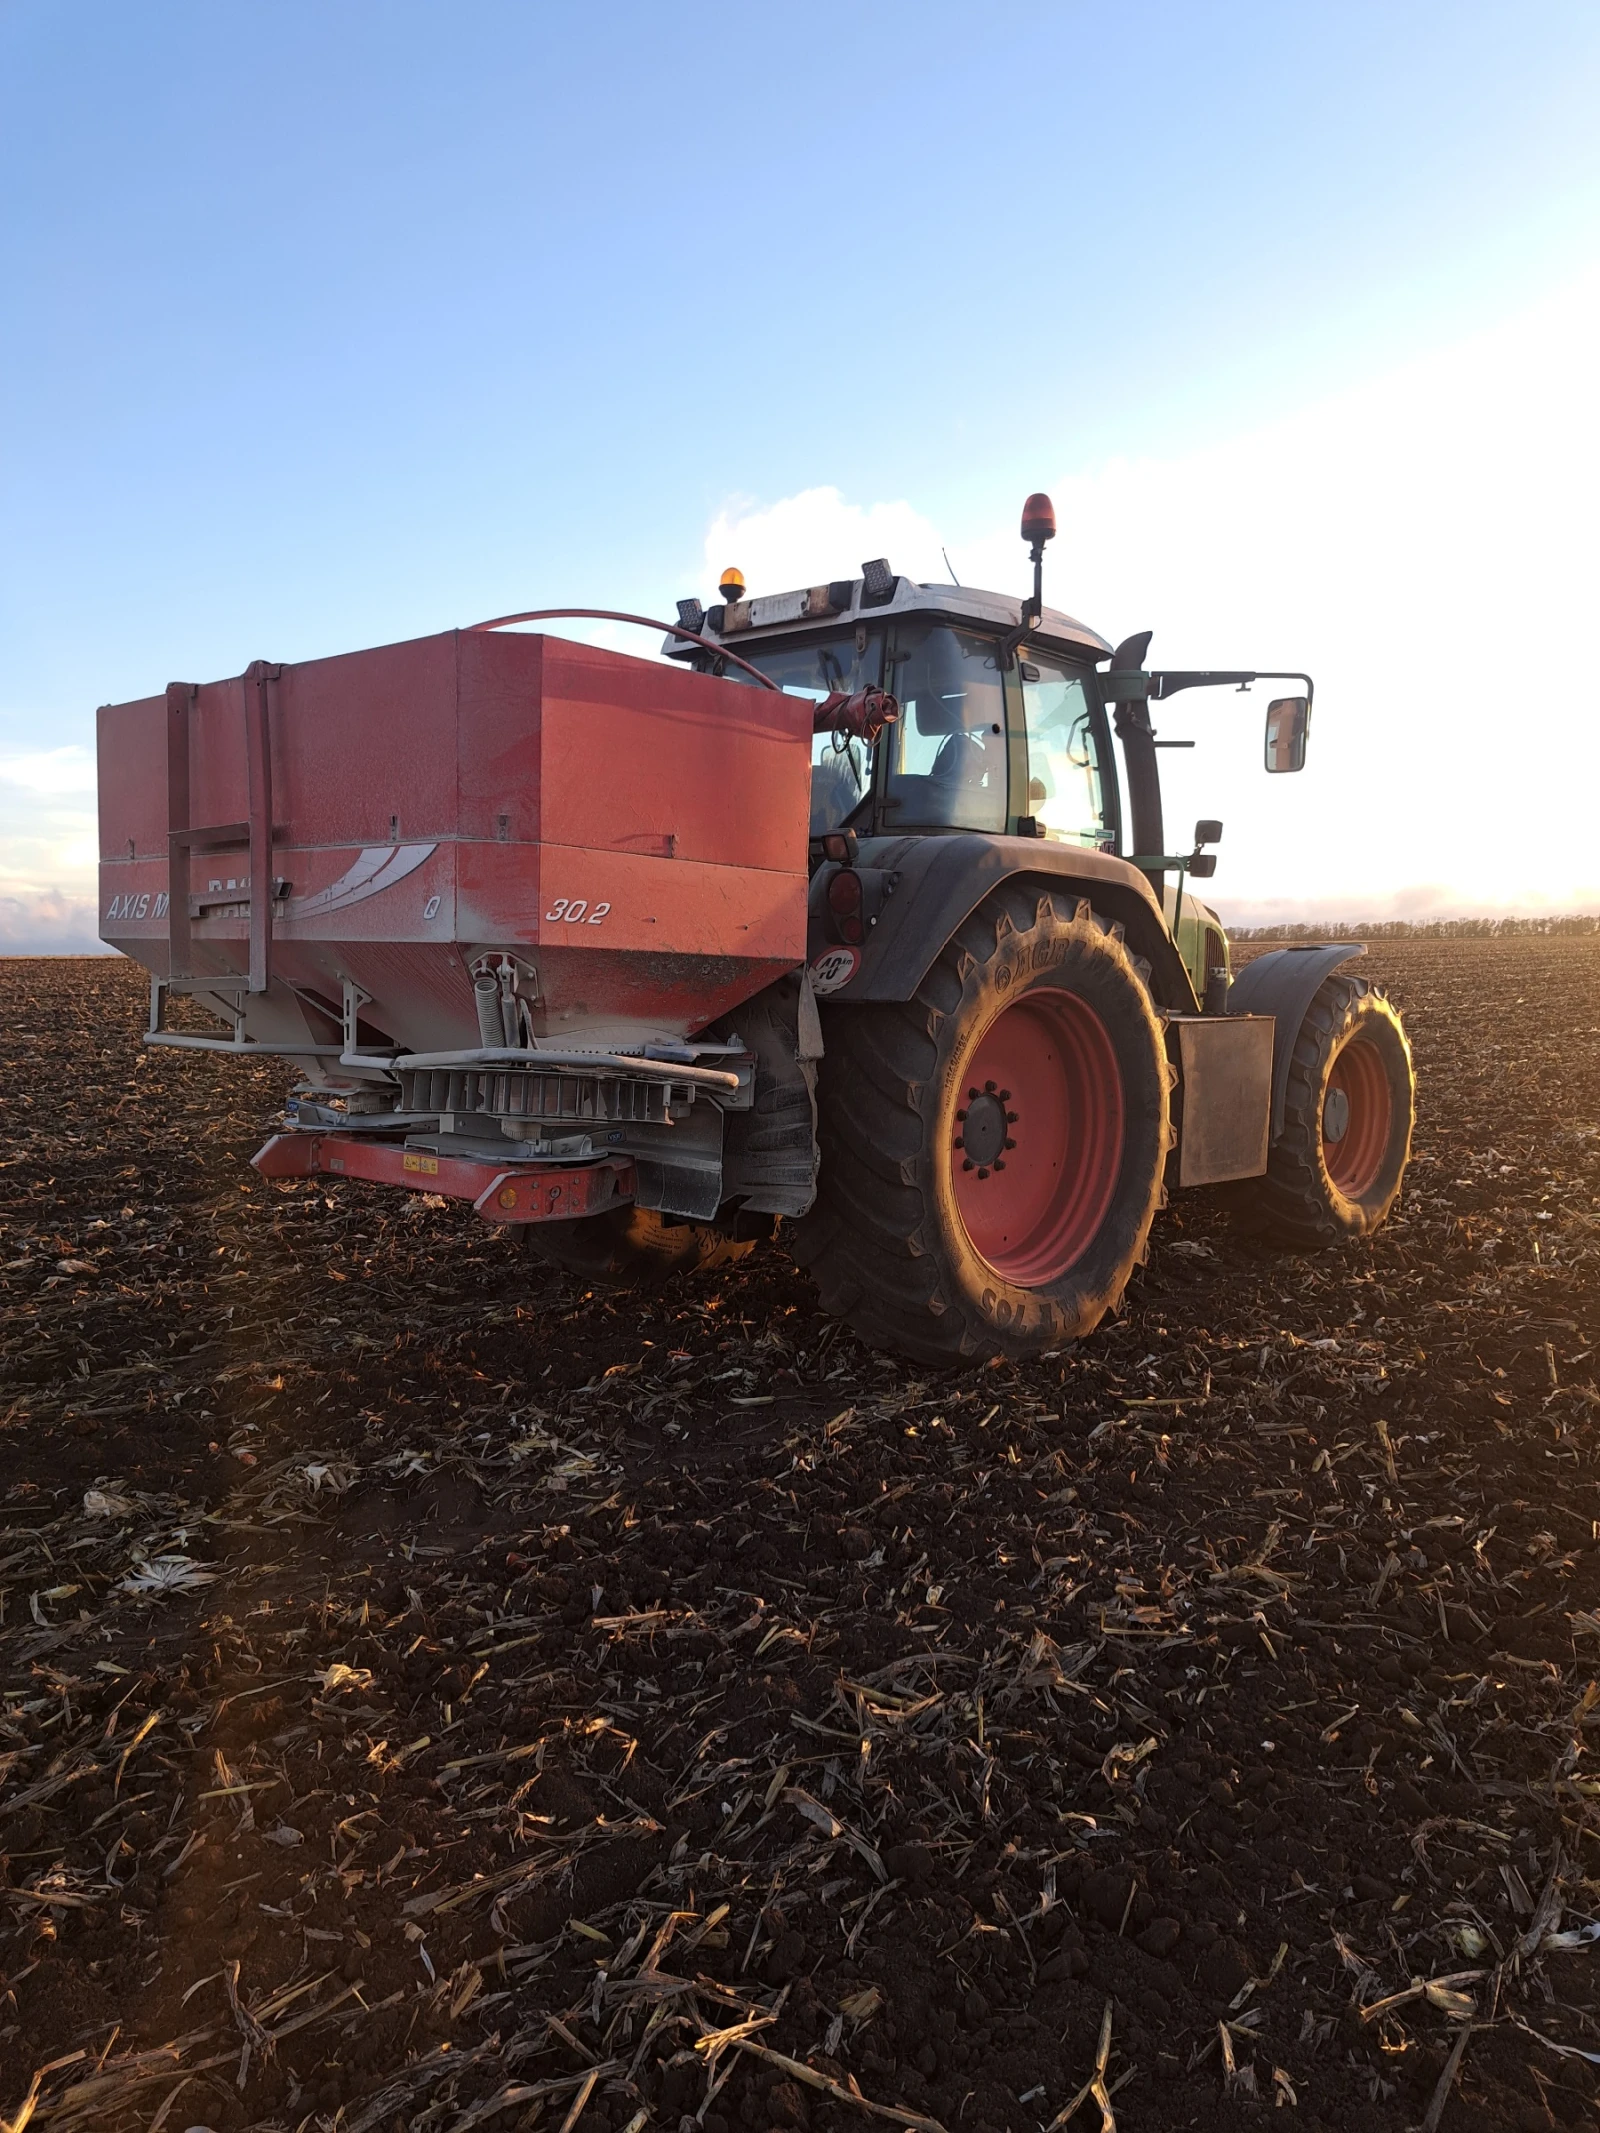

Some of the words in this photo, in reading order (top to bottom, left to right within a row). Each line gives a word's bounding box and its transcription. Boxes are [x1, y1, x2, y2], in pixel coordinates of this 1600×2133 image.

[106, 894, 151, 919] AXIS
[151, 893, 169, 918] M
[545, 899, 611, 925] 30.2
